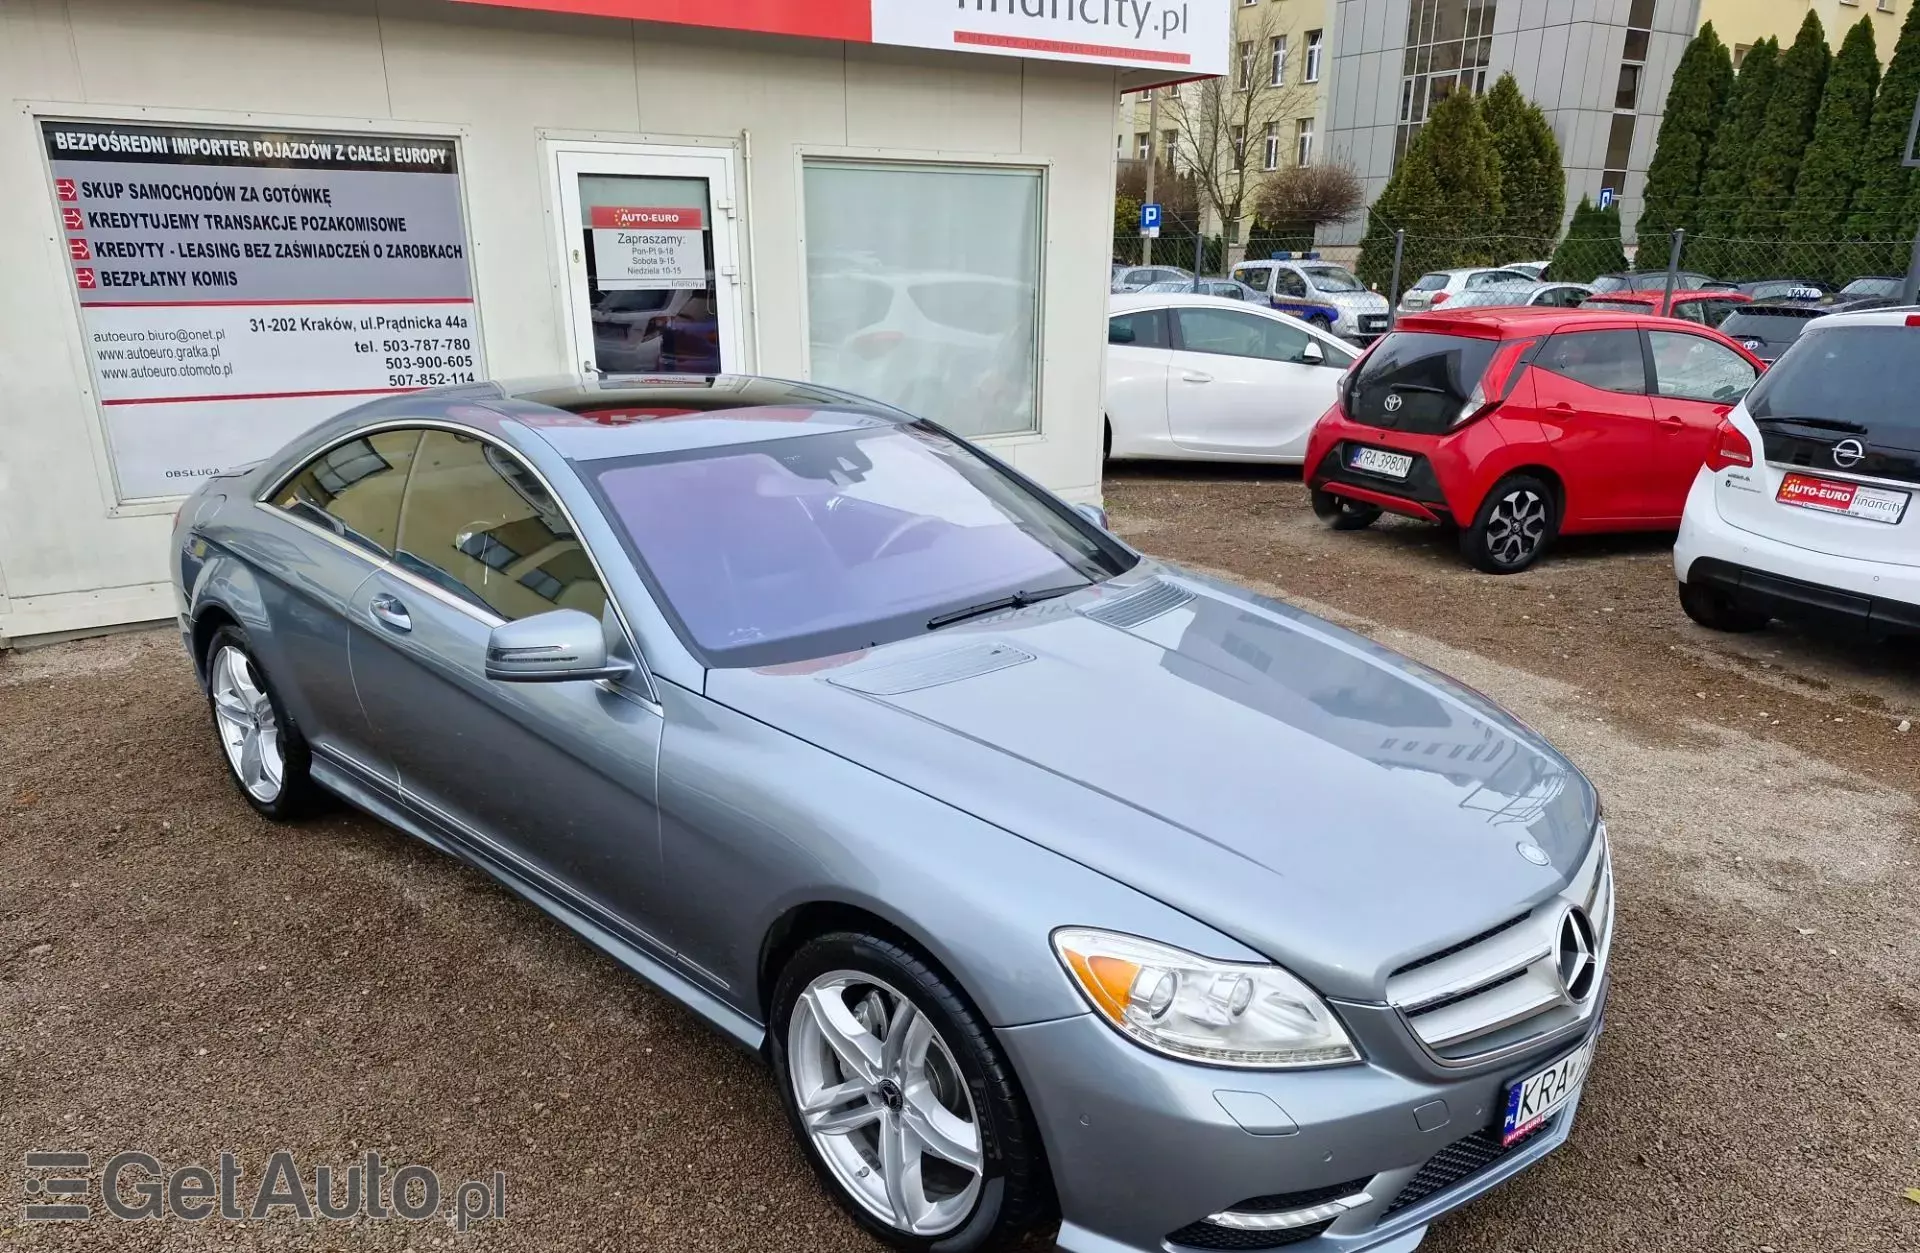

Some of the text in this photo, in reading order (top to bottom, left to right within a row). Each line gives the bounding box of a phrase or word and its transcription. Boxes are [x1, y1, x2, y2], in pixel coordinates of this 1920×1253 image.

[55, 131, 446, 164] BEZPOŚREDNI IMPORTER POJAZDÓW Z CAŁEJ EUROPY
[82, 181, 331, 207] SKUP SAMOCHODÓW ZA GOTÓWKĘ
[1600, 191, 1610, 211] P
[88, 212, 407, 232] KREDYTUJEMY TRANSAKCJE POZAKOMISOWE
[621, 213, 679, 222] AUTO-EURO
[1145, 207, 1157, 225] P
[617, 233, 686, 247] Zapraszamy:
[94, 241, 165, 258] KREDYTY
[178, 242, 240, 258] LEASING
[243, 243, 272, 258] BEZ
[275, 240, 370, 259] ZAŚWIADCZEŃ
[374, 244, 383, 258] O
[386, 244, 463, 259] ZAROBKACH
[632, 247, 674, 255] Pon-Pt 9-18
[632, 257, 676, 265] Sobota 9-15
[101, 271, 238, 287] BEZPŁATNY KOMIS
[627, 267, 682, 275] Niedziela 10-15
[1791, 288, 1812, 298] TAXI
[249, 315, 468, 333] 31-202 Kraków, ul.Prądnicka 44a
[93, 329, 226, 343] autoeuro.biuro@onet.pl
[97, 344, 221, 361] www.autoeuro.gratka.pl
[354, 338, 471, 353] tel. 503-787-780
[386, 355, 473, 369] 503-900-605
[101, 362, 233, 379] www.autoeuro.otomoto.pl
[389, 372, 475, 386] 507-852-114
[1360, 450, 1377, 466] KRA
[165, 467, 220, 478] OBSŁUGA
[1787, 482, 1851, 502] AUTO-EURO
[1853, 494, 1904, 515] financity
[1504, 1114, 1515, 1127] PL
